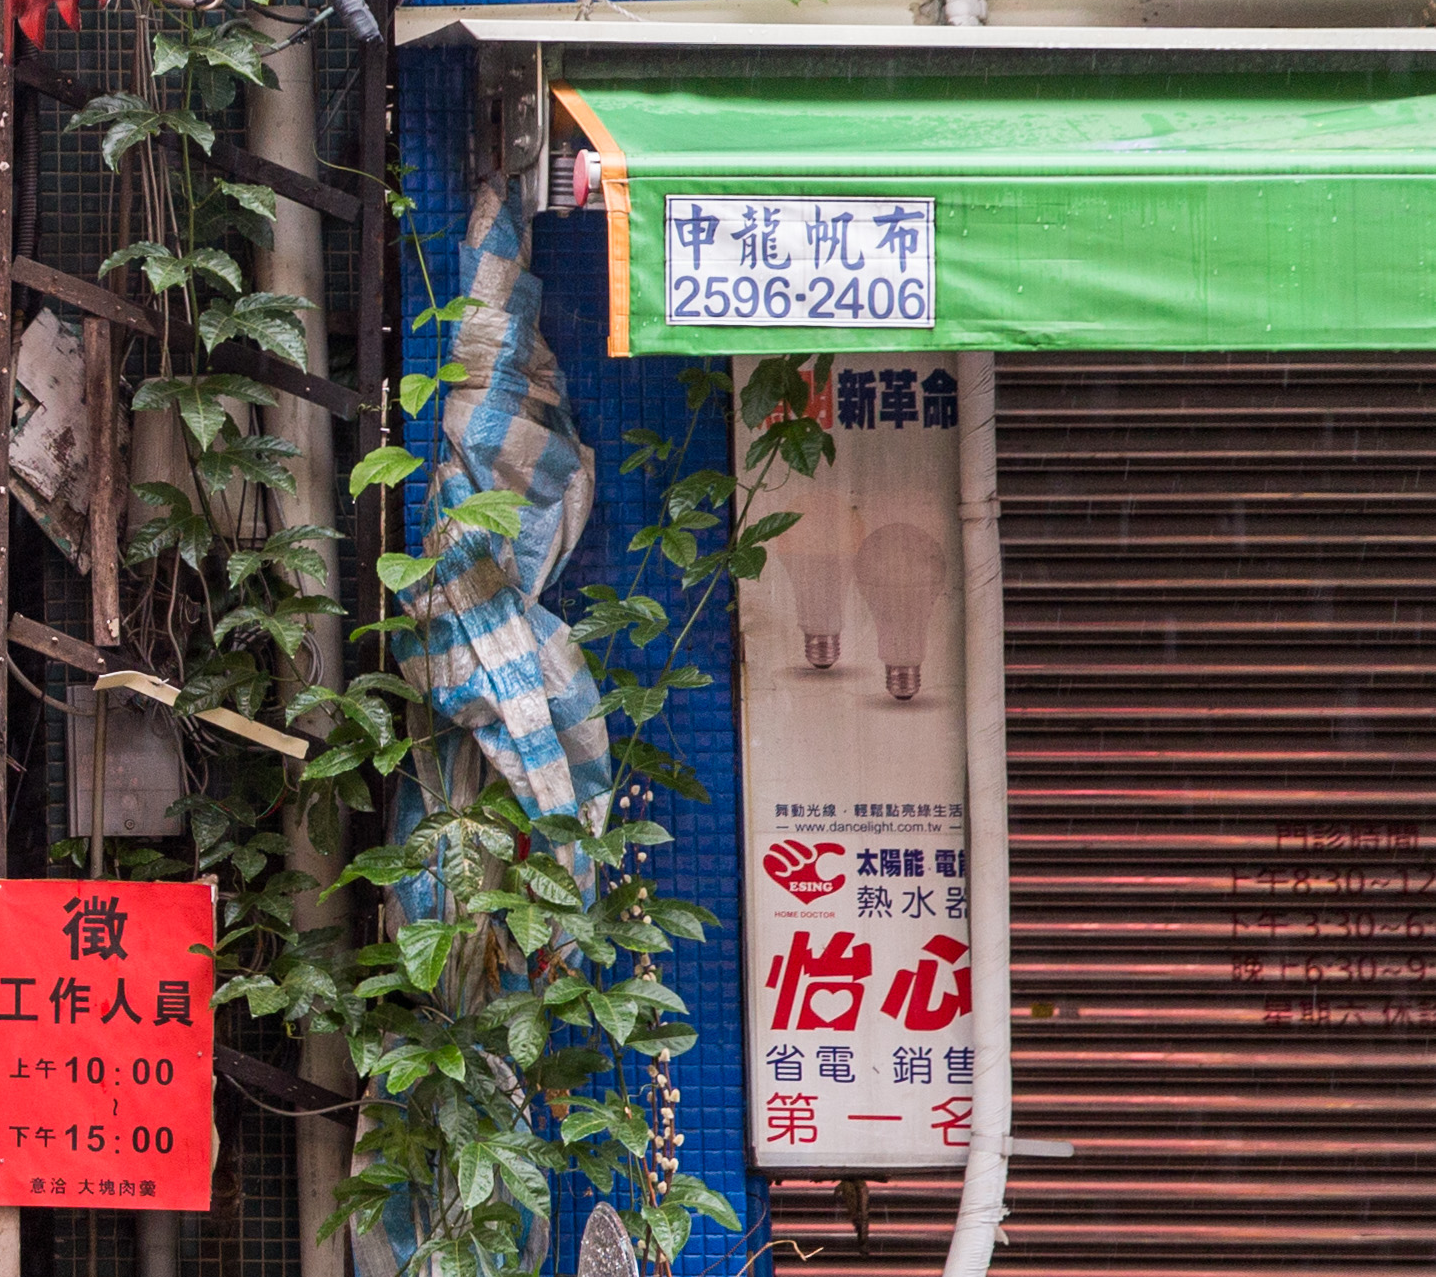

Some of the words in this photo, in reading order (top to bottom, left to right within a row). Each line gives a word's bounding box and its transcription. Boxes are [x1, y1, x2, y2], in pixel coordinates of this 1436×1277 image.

[672, 205, 924, 273] 申龍帆布
[673, 277, 925, 321] 2596-2406
[795, 822, 942, 835] www.dancelight.com.tw
[789, 881, 834, 893] ESING
[62, 895, 128, 961] 徵
[774, 910, 799, 919] HOME
[801, 910, 836, 919] DOCTOR
[765, 931, 973, 1031] 怡心
[9, 1056, 174, 1086] 上午10:00
[766, 1091, 973, 1147] 第一名
[9, 1124, 174, 1154] 下午15:00
[78, 1178, 157, 1198] 大塊肉羹
